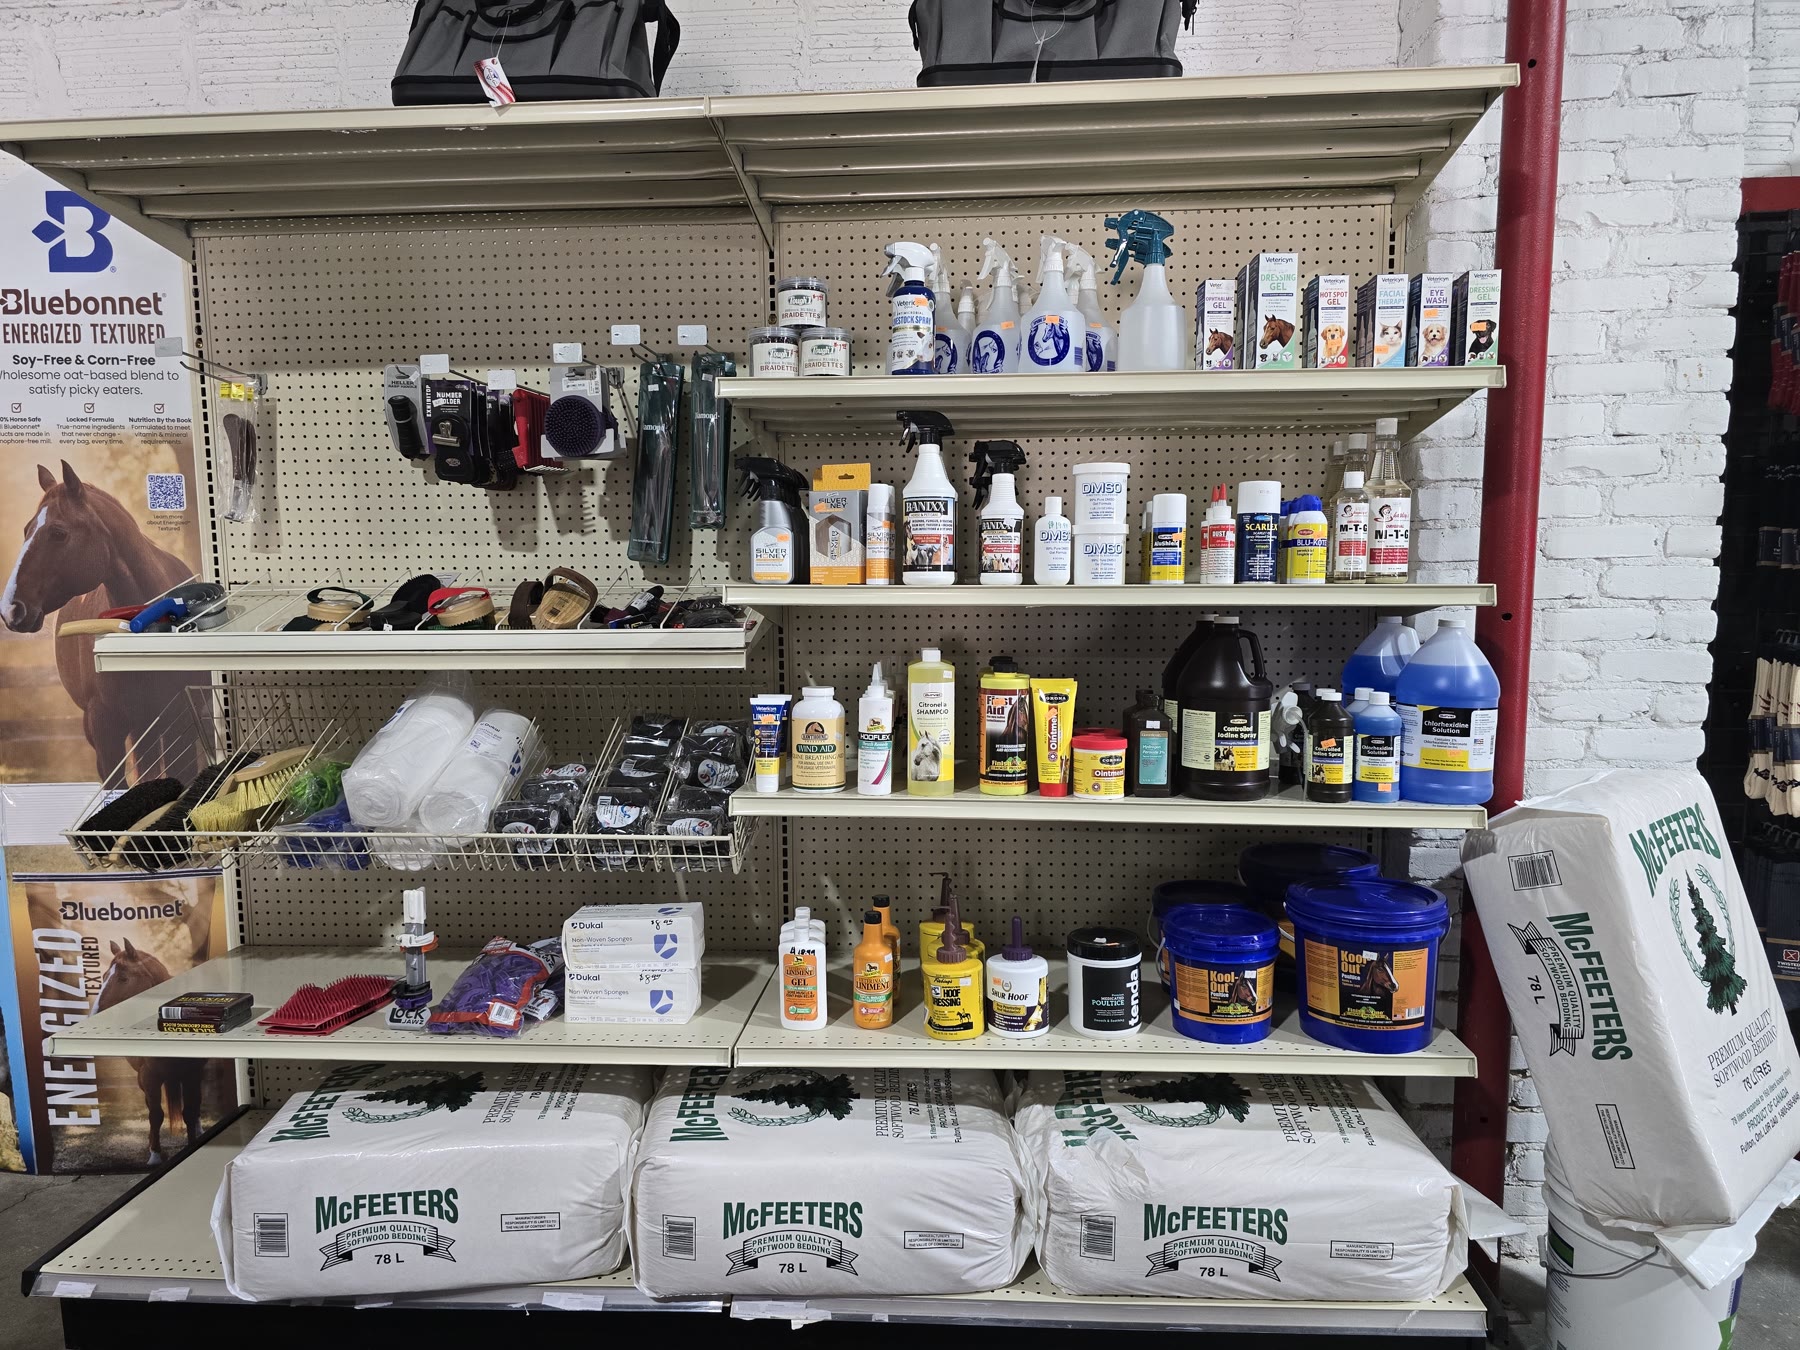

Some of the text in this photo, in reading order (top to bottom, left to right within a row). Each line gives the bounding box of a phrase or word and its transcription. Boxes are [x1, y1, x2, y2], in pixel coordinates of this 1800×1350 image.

[1260, 273, 1297, 282] DRESSING
[1269, 282, 1288, 291] GEL
[1429, 289, 1445, 297] EYE
[1326, 298, 1341, 306] GEL
[1378, 298, 1406, 306] THERAPY
[1476, 293, 1492, 301] GEL
[3, 323, 82, 344] ENERGIZED
[12, 354, 156, 368] Soy-Free & Corn-Free
[804, 361, 844, 369] BRAIDETTES
[64, 370, 180, 381] oat-based blend to
[29, 385, 143, 398] satisfy picky eaters.
[436, 391, 463, 399] NUMBER
[1081, 482, 1123, 495] DMSO
[906, 501, 946, 512] BANIXX
[1083, 543, 1123, 555] DMSO
[986, 706, 1005, 715] Aid
[1423, 720, 1469, 729] Chlorhexidine
[1239, 732, 1257, 740] Spray
[797, 744, 834, 753] WIND AID
[1628, 802, 1722, 898] McFEETERS
[60, 900, 183, 921] Bluebonnet
[578, 921, 604, 930] Dukal
[607, 935, 633, 944] Sponges
[82, 935, 101, 997] TEXTURED
[1340, 961, 1361, 974] Out
[575, 973, 601, 981] Dukal
[791, 978, 809, 986] GEL
[1210, 970, 1239, 983] Kool-
[943, 988, 961, 997] HOOF
[1210, 981, 1229, 993] Out
[1526, 974, 1543, 1005] 78 L
[1542, 947, 1572, 1028] SOFTWOOD BEDDING
[1546, 911, 1634, 1061] McFEETERS
[1548, 945, 1581, 1029] PREMIUM QUALITY
[991, 988, 1029, 1001] SHUR HOOF
[1126, 968, 1139, 1026] tenda
[1091, 999, 1125, 1007] POULTICE
[388, 1007, 427, 1024] LOCK
[1707, 1008, 1773, 1071] PREMIUM QUALITY
[1713, 1048, 1754, 1088] SOFTWOOD
[1741, 1076, 1753, 1092] 78
[482, 1086, 513, 1124] PREMIUM
[498, 1084, 528, 1123] SOFTWOOD
[906, 1082, 920, 1116] 78 LITRES
[1307, 1102, 1320, 1112] 78
[1746, 1106, 1769, 1133] PRODUCT
[1766, 1101, 1774, 1114] OF
[1772, 1086, 1790, 1108] CANADA
[874, 1096, 889, 1137] PREMIUM
[889, 1095, 904, 1139] SOFTWOOD
[1266, 1091, 1301, 1143] PREMIUM
[1281, 1090, 1317, 1144] SOFTWOOD
[315, 1187, 459, 1234] McFEETERS
[723, 1201, 863, 1239] McFEETERS
[1143, 1203, 1288, 1246] McFEETERS
[345, 1224, 428, 1240] PREMIUM QUALITY
[346, 1233, 427, 1248] SOFTWOOD BEDDING
[752, 1233, 832, 1247] PREMIUM QUALITY
[1173, 1238, 1256, 1253] PREMIUM QUALITY
[752, 1242, 831, 1256] SOFTWOOD BEDDING
[1173, 1246, 1254, 1261] SOFTWOOD BEDDING
[374, 1253, 405, 1265] 78 L
[778, 1262, 807, 1273] 78 L
[1199, 1267, 1229, 1277] 78 L
